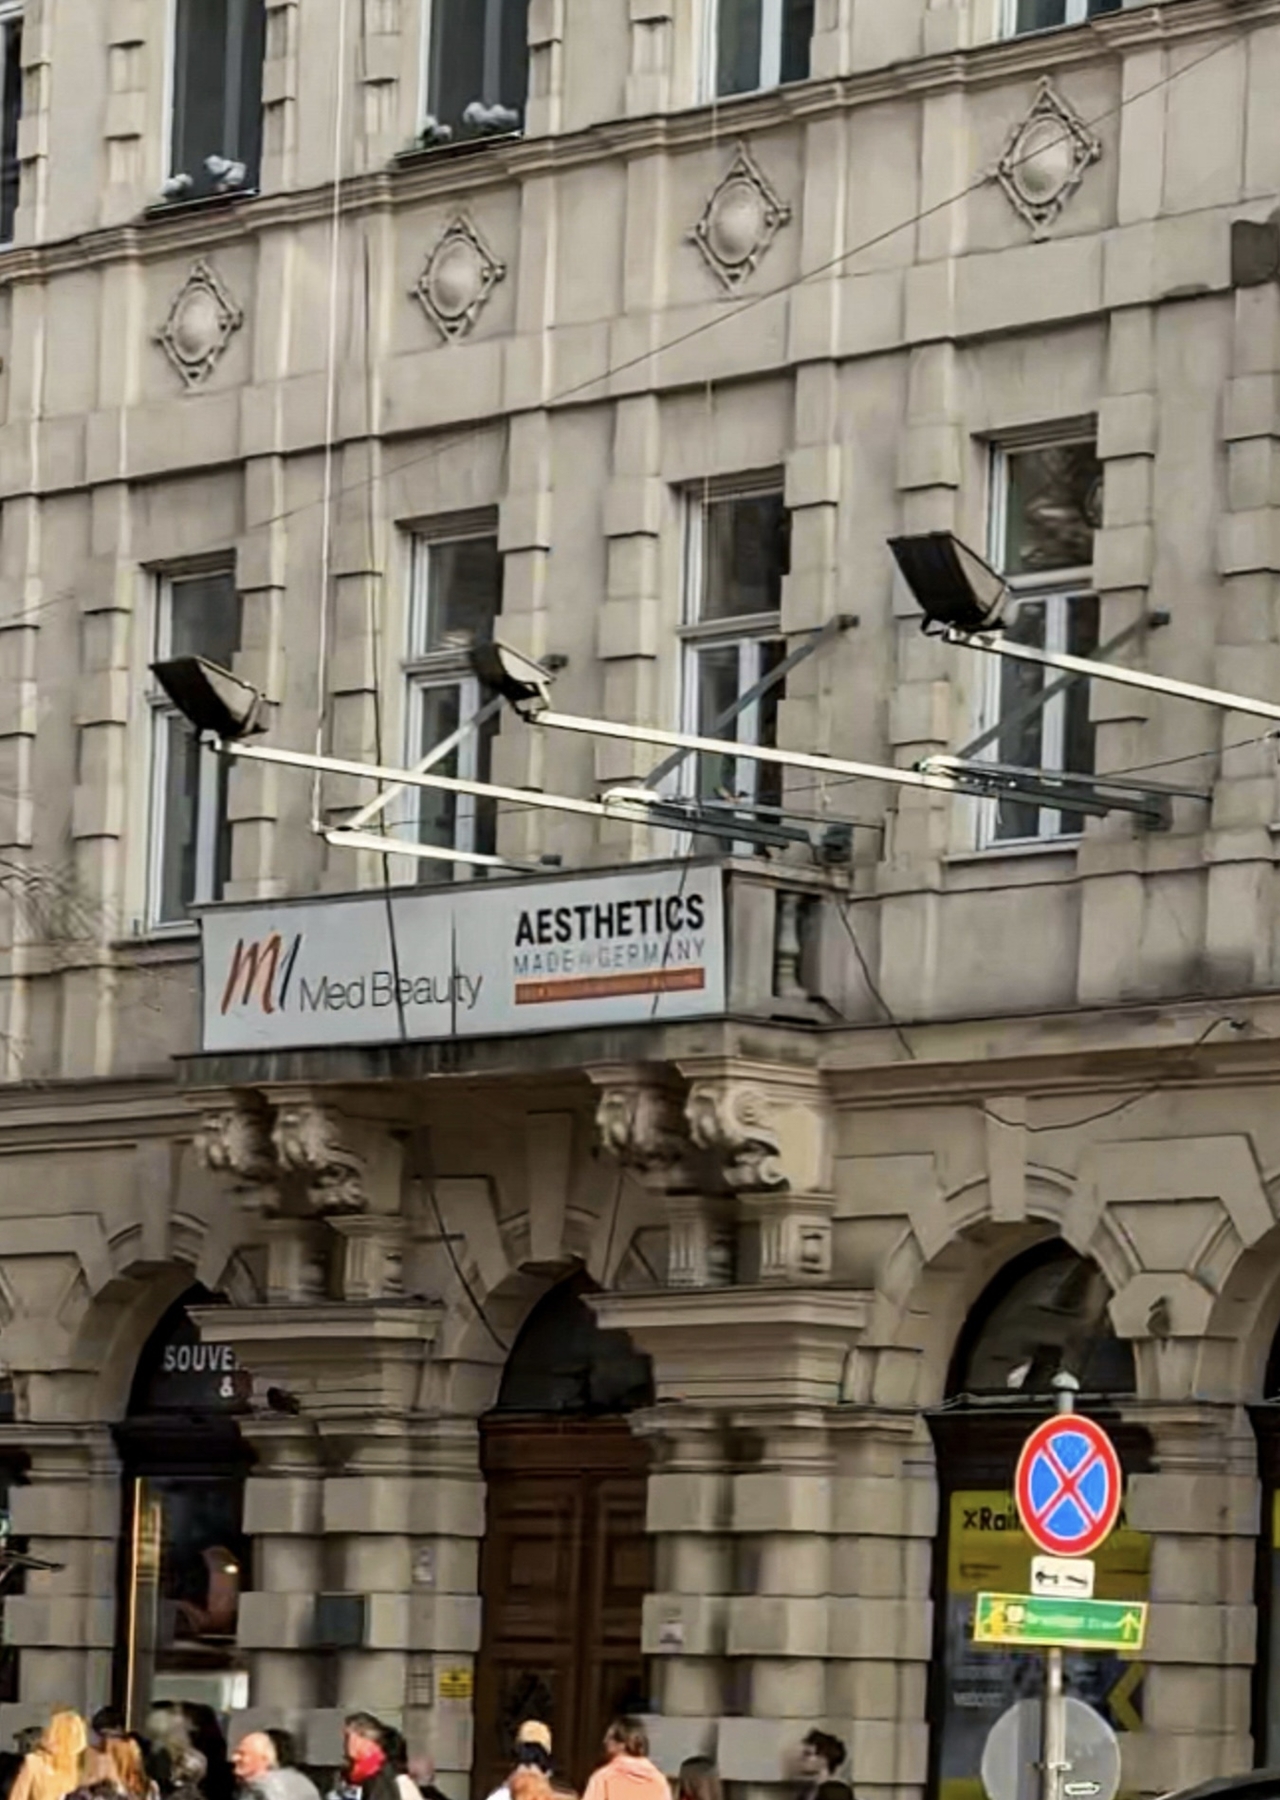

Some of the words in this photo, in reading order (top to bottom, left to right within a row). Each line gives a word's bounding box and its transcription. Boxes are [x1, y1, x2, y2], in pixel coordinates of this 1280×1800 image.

[515, 893, 705, 947] AESTHETICS
[514, 949, 575, 975] MADE
[599, 937, 705, 970] GERMANY
[163, 1344, 241, 1371] SOUVE
[219, 1375, 234, 1398] &
